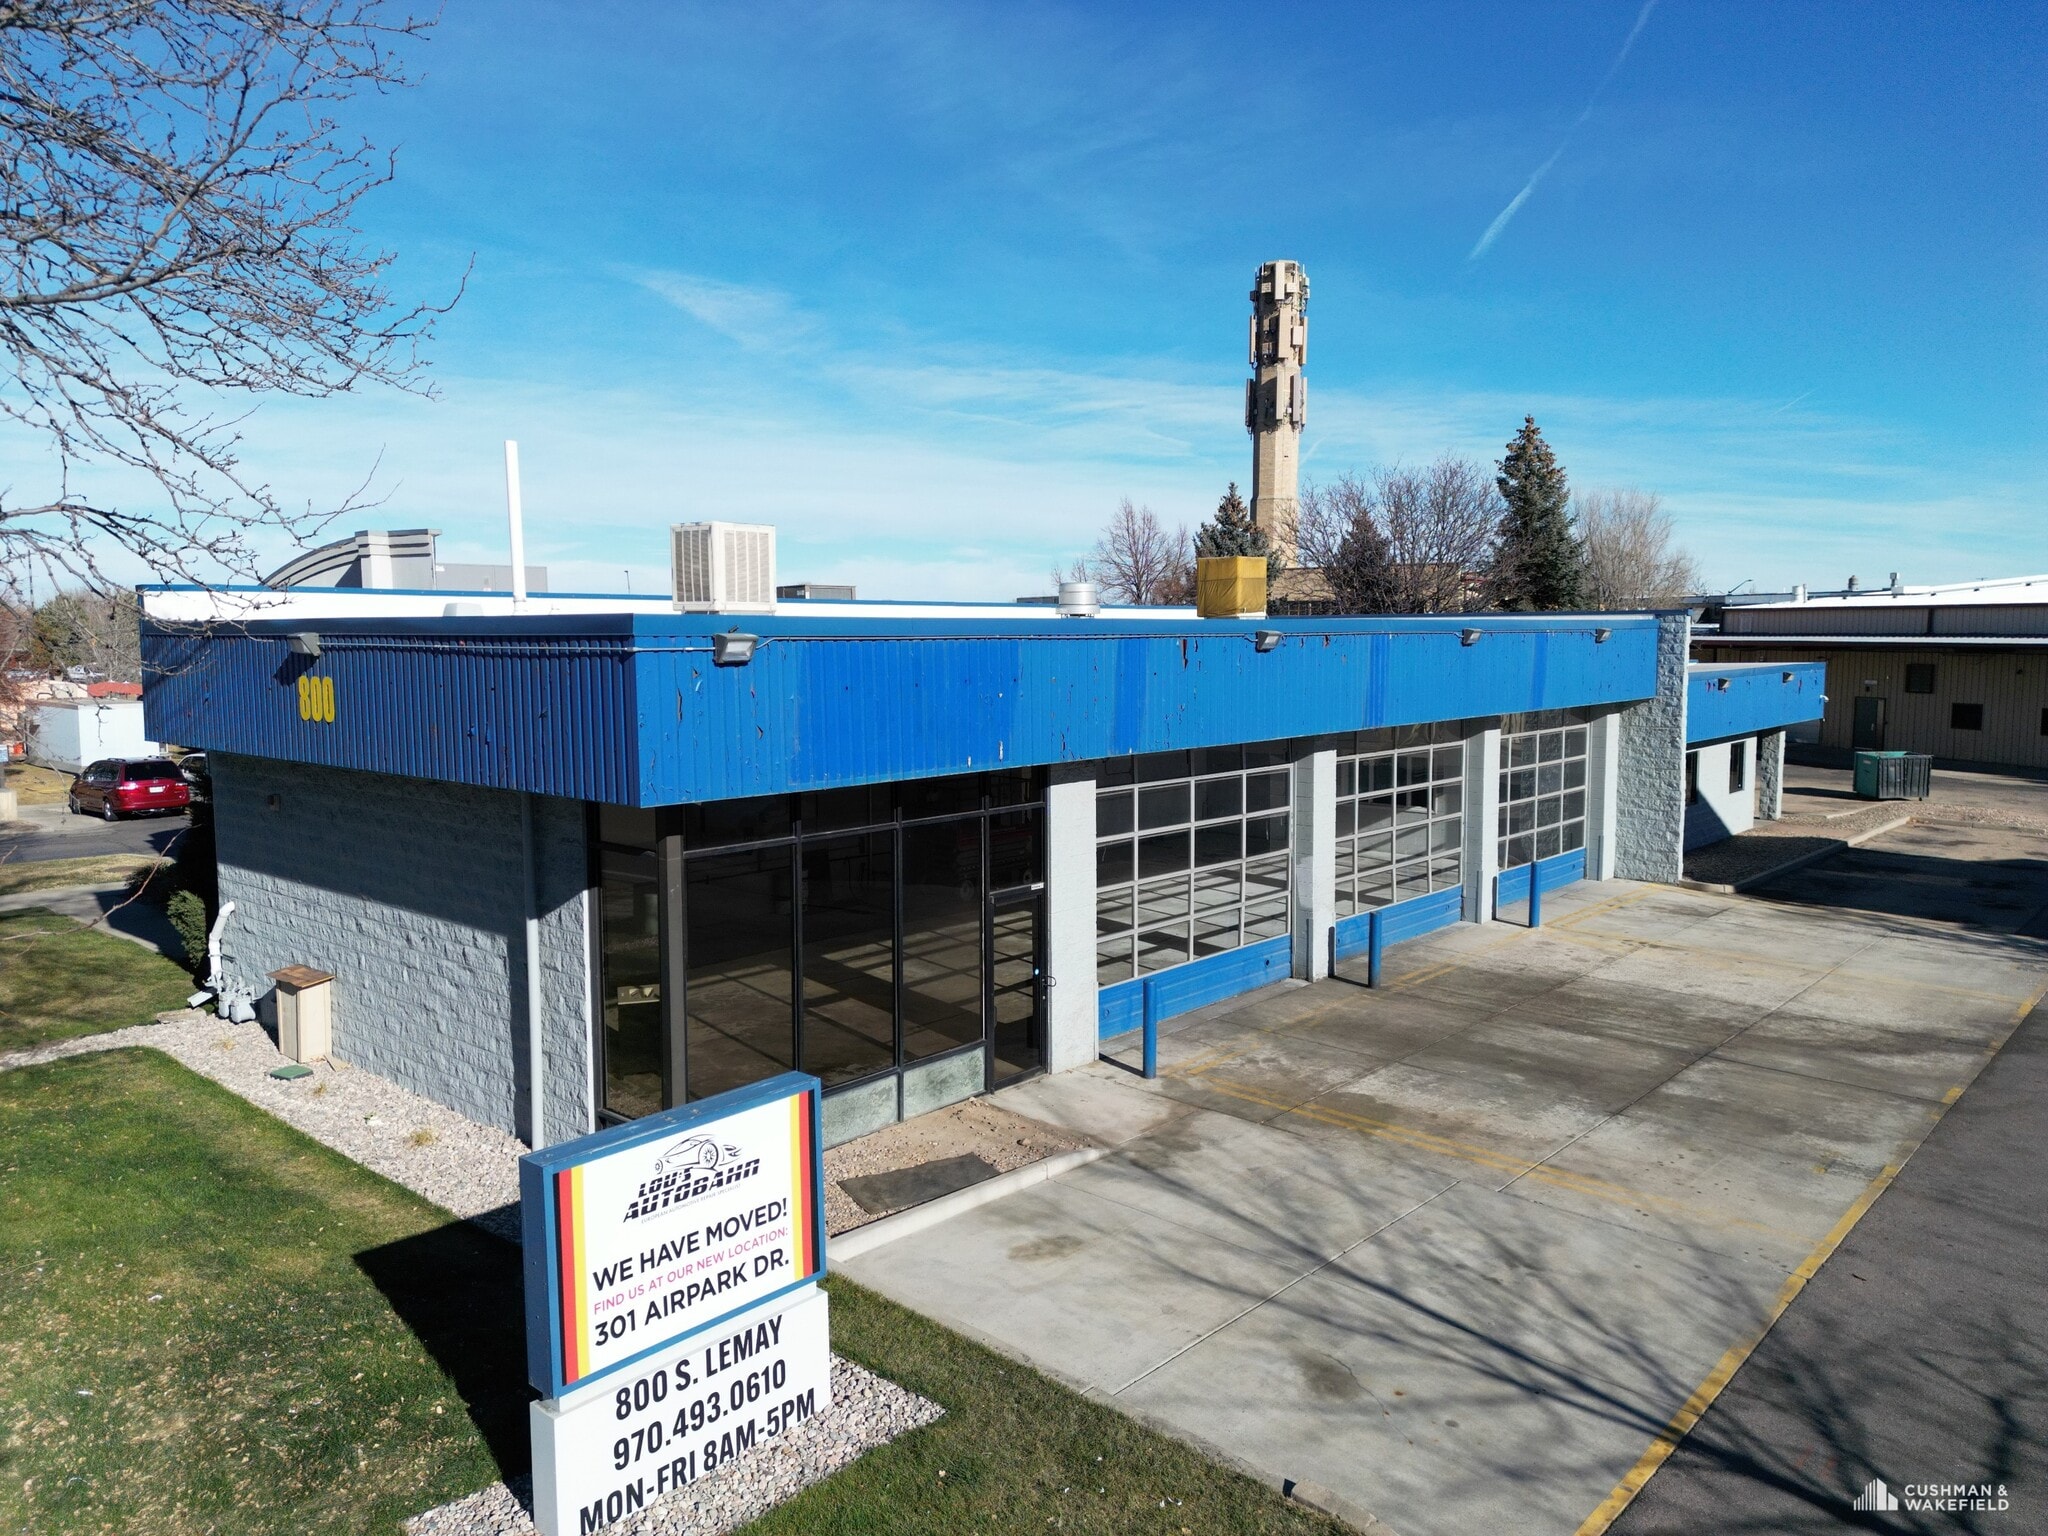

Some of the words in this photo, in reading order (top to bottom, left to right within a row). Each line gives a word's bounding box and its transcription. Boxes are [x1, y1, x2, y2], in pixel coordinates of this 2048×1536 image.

[298, 675, 335, 723] 800
[623, 1158, 760, 1223] AUTOBAHN
[638, 1166, 693, 1198] LOU'S
[592, 1256, 634, 1292] WE
[640, 1230, 700, 1274] HAVE
[706, 1197, 789, 1247] MOVED!
[594, 1293, 625, 1315] FIND
[628, 1284, 645, 1300] US
[648, 1275, 663, 1292] AT
[667, 1264, 694, 1284] OUR
[697, 1250, 726, 1271] NEW
[728, 1227, 789, 1259] LOCATION:
[594, 1309, 636, 1347] 301
[644, 1262, 748, 1327] AIRPARK
[754, 1248, 790, 1279] DR.
[613, 1358, 787, 1471] 970.493.0610
[615, 1370, 668, 1421] 800
[674, 1359, 699, 1391] S.
[705, 1314, 783, 1378] LEMAY
[579, 1450, 696, 1536] MON-FRI
[703, 1387, 816, 1472] 8AM-5PM
